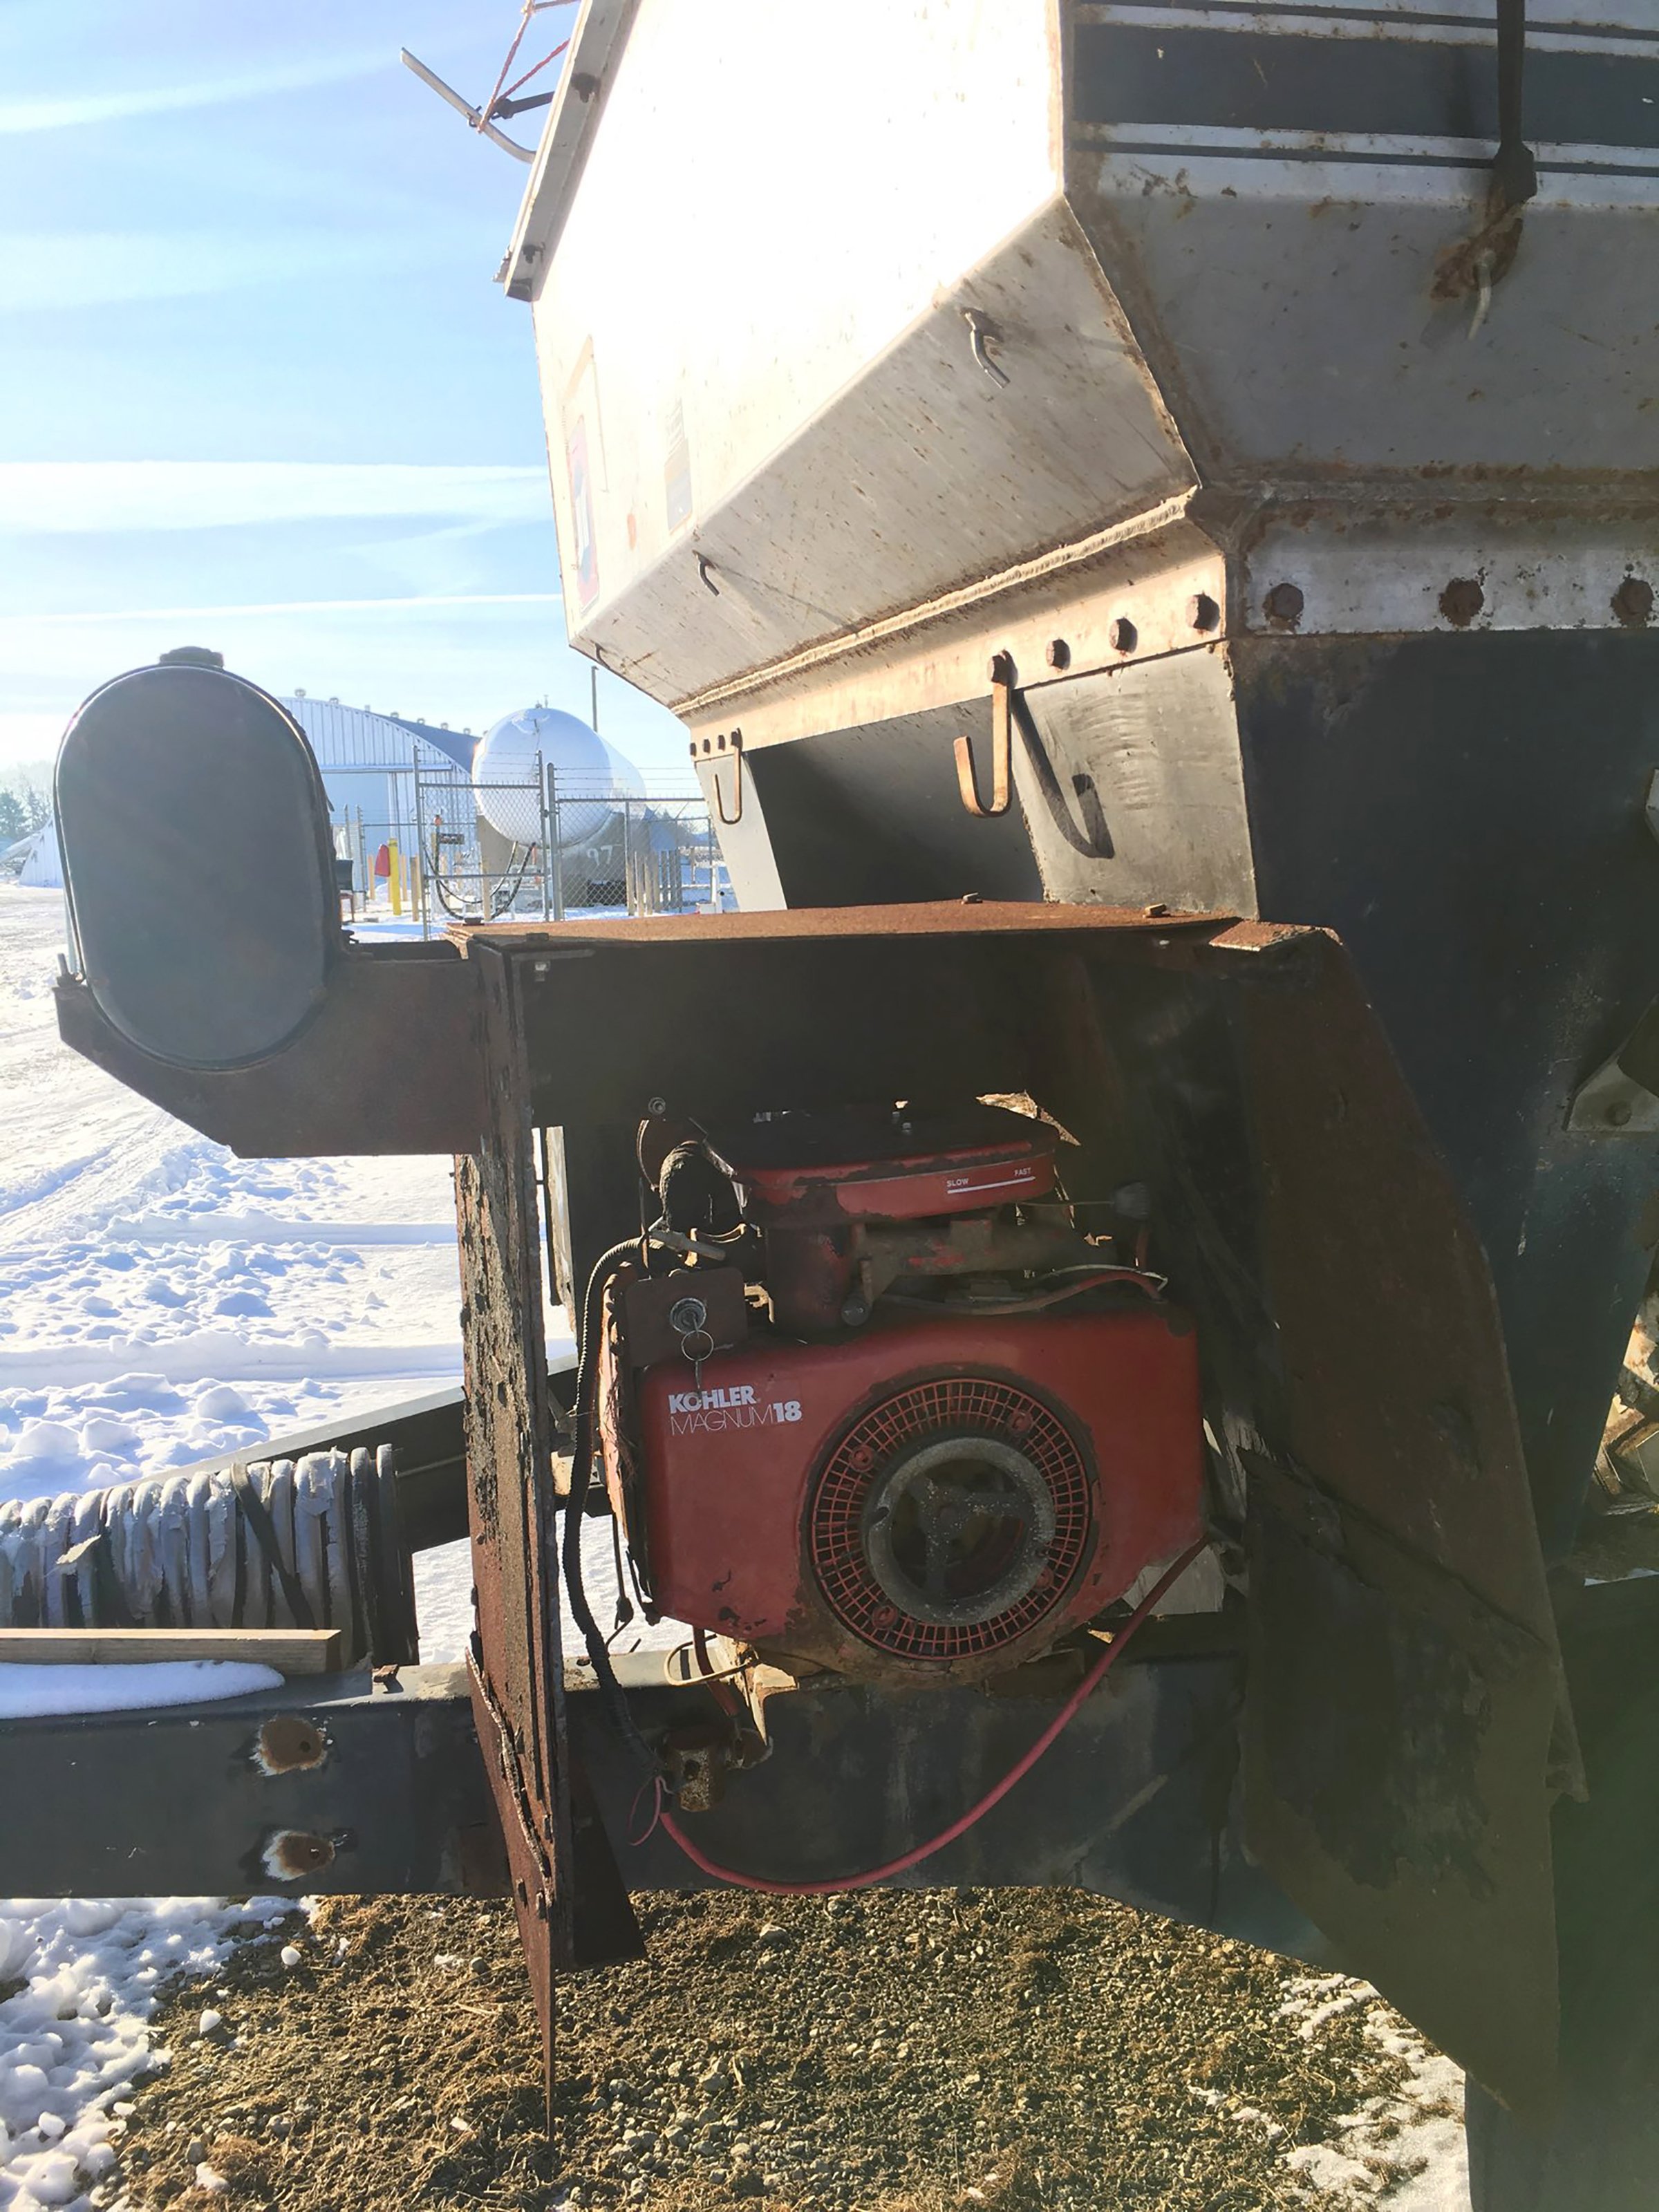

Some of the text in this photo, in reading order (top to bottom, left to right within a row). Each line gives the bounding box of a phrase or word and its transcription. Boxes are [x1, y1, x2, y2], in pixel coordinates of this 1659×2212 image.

[586, 845, 613, 865] 97
[947, 1167, 1031, 1188] SLOW FAST
[668, 1385, 757, 1414] KOHLER
